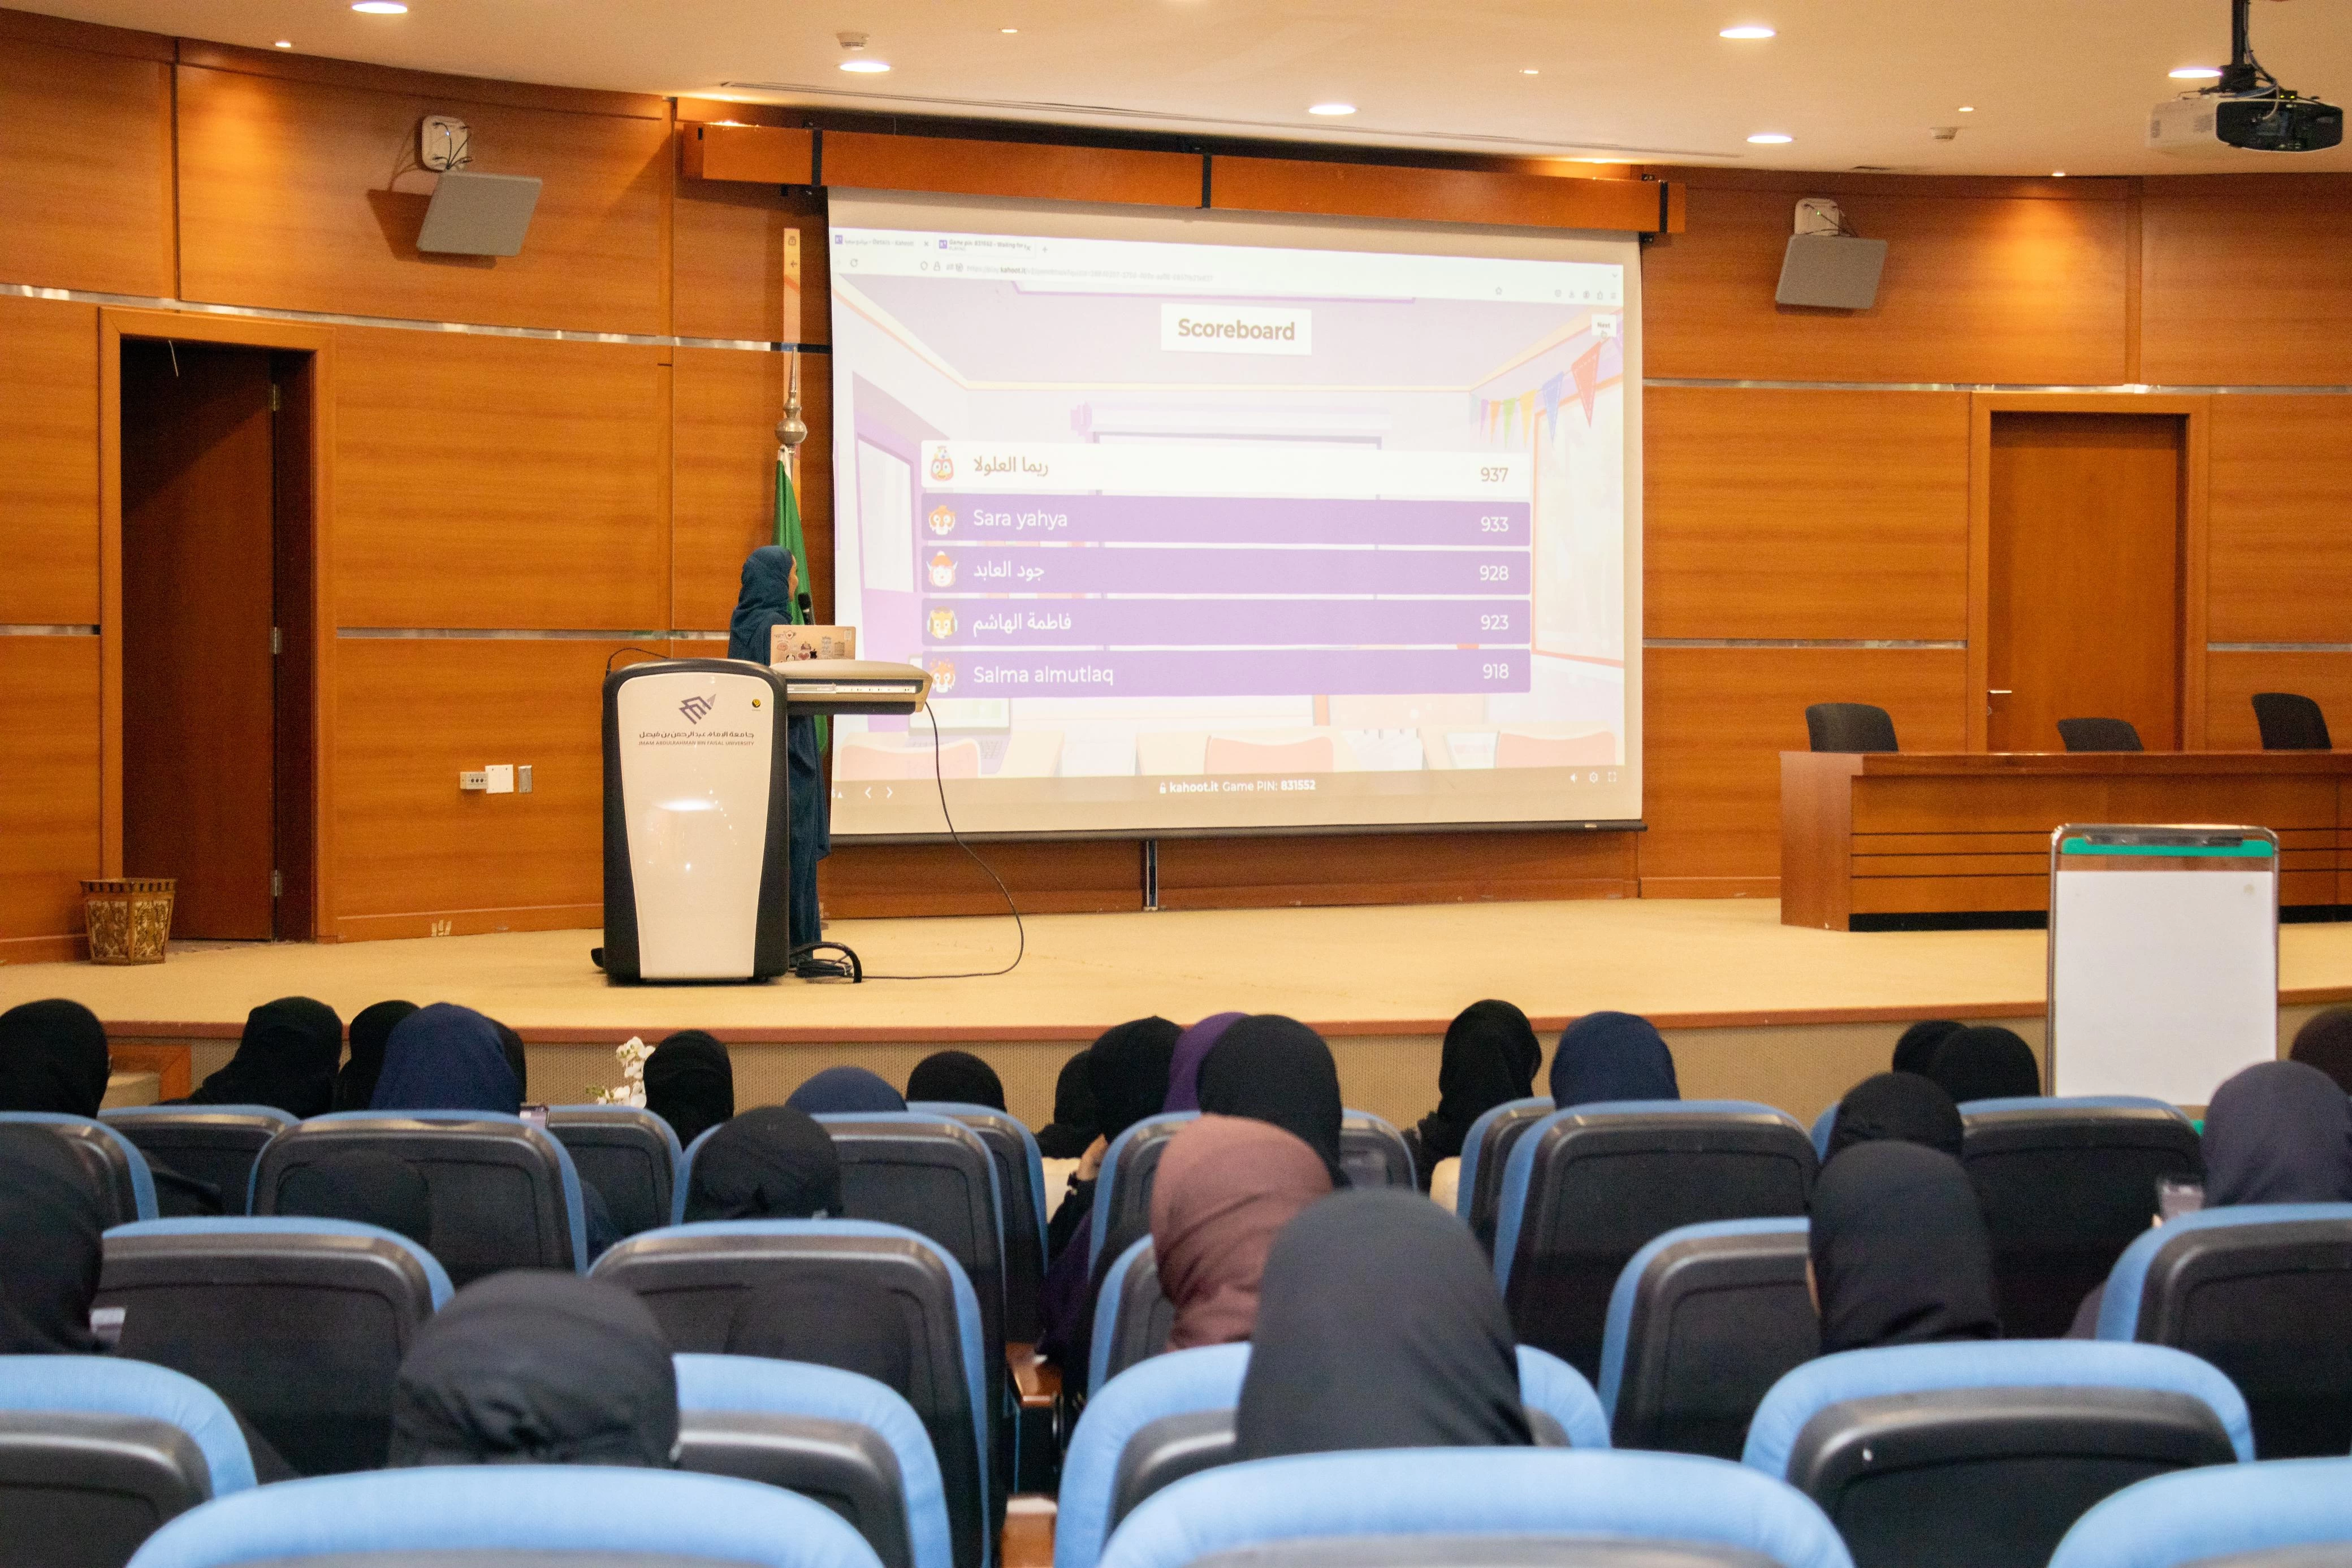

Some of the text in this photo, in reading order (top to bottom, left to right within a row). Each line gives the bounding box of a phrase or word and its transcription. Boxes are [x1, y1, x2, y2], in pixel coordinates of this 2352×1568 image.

[1178, 317, 1295, 341] Scoreboard
[974, 455, 1049, 477] ريما العلولا
[1480, 467, 1508, 483] 937
[974, 509, 1067, 530] Sara yahya
[1481, 517, 1509, 532] 933
[974, 560, 1044, 582] جود العابد
[1480, 565, 1509, 581] 928
[973, 612, 1072, 638] فاطمة الهاشم
[1481, 614, 1509, 630] 923
[974, 665, 1113, 686] Salma almutlaq
[1482, 664, 1509, 679] 918
[1169, 779, 1316, 794] kahoot.it Game PIN: 831552
